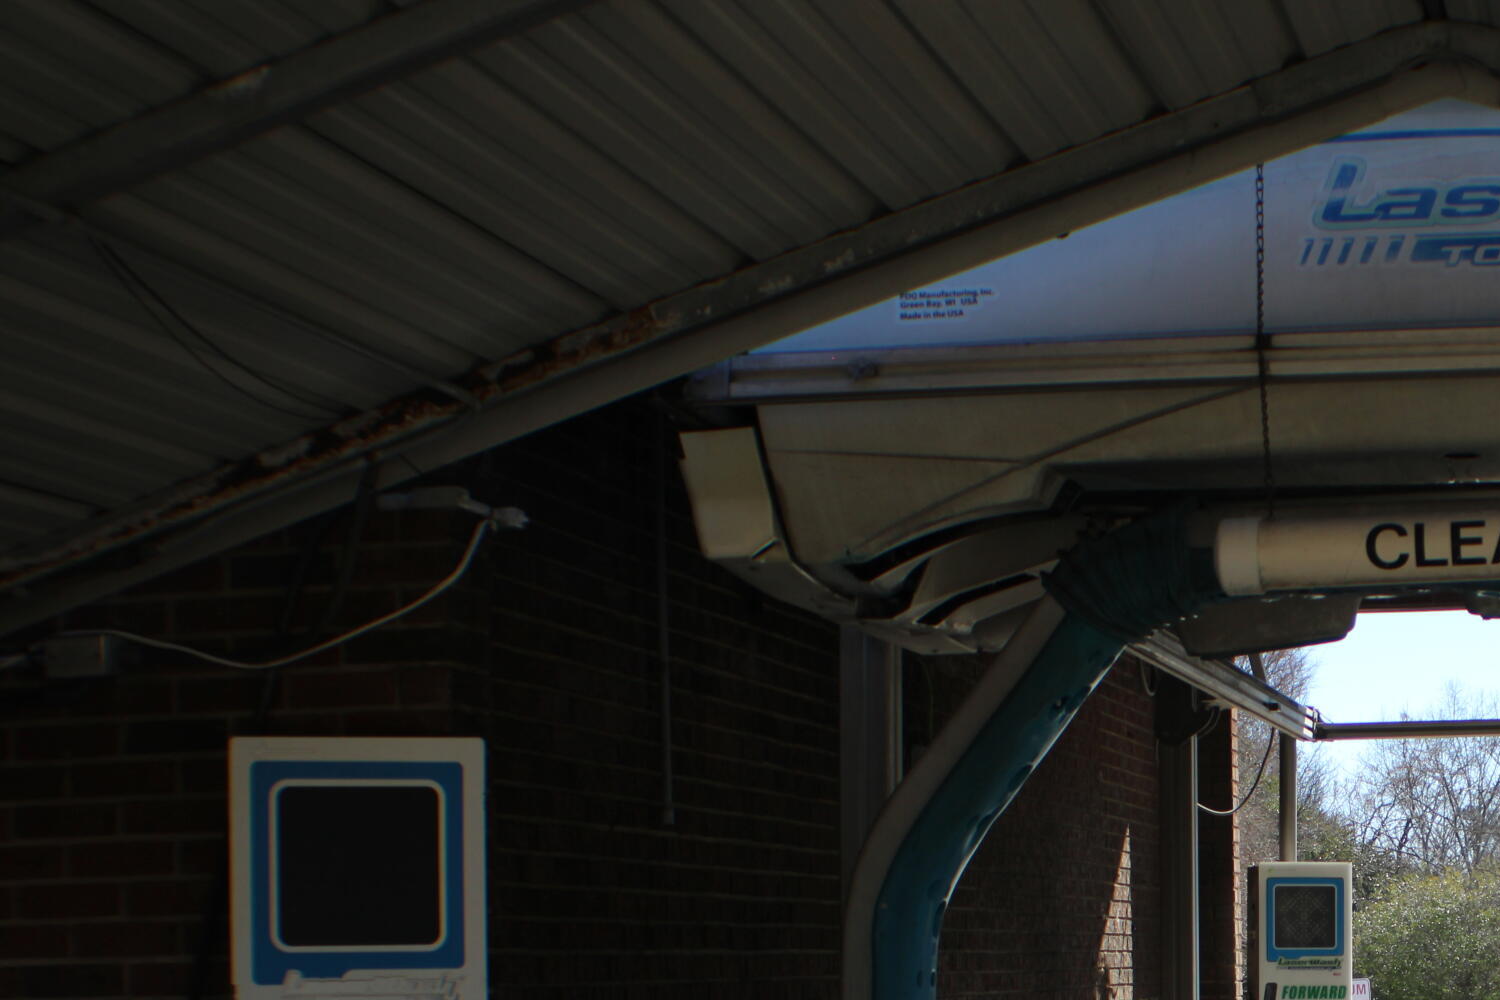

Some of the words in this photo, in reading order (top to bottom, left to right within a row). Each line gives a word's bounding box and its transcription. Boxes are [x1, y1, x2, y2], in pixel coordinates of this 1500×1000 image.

[960, 297, 978, 305] USA
[899, 312, 922, 320] Made
[933, 311, 945, 319] the
[947, 310, 964, 318] USA
[1281, 985, 1348, 1000] FORWARD
